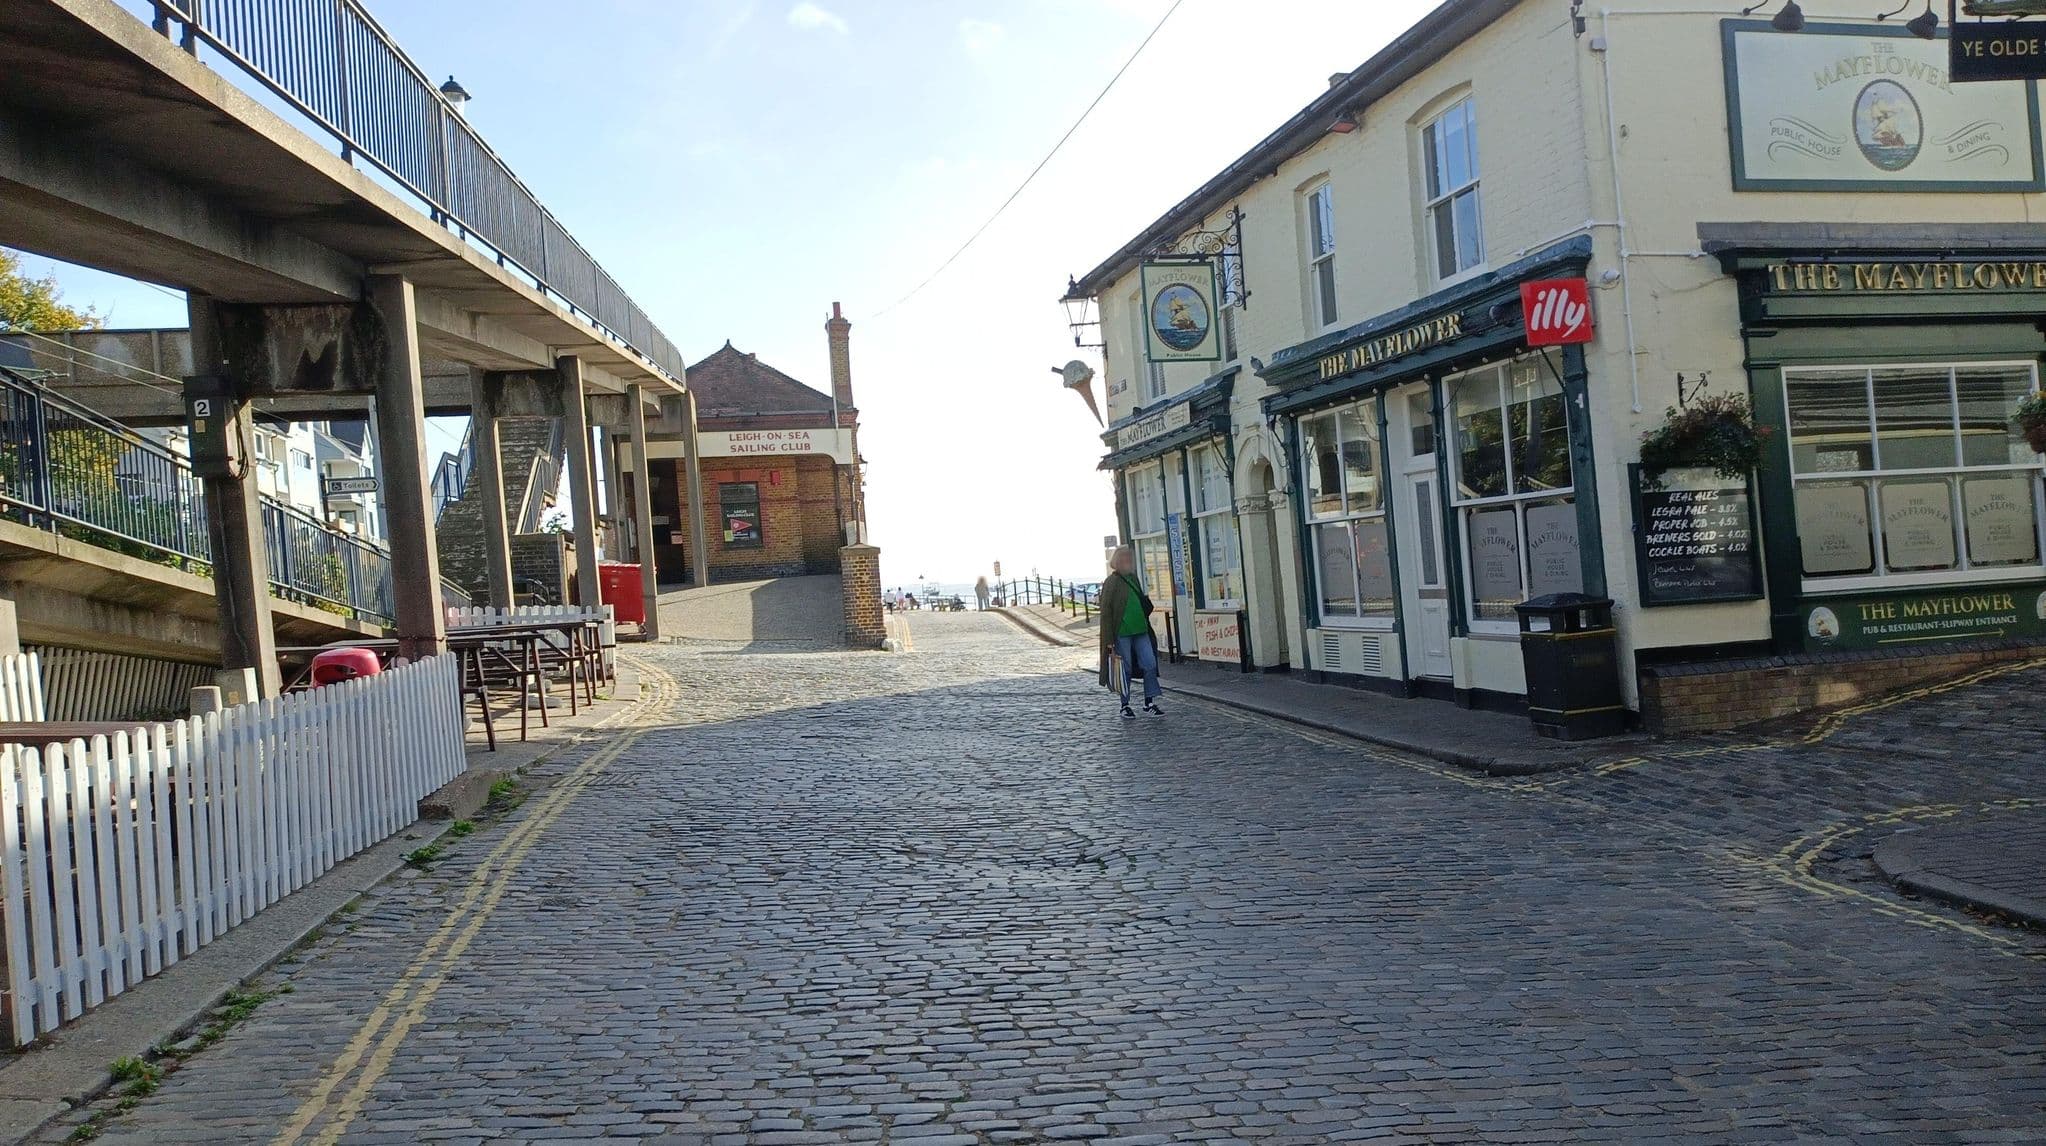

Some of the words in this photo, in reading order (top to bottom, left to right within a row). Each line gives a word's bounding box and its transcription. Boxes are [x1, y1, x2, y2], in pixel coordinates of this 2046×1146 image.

[1962, 41, 1984, 56] YE
[1990, 40, 2039, 56] OLDE
[1814, 54, 1954, 95] MAYFLOWER
[1771, 127, 1805, 144] PUBLIC
[1808, 138, 1841, 156] HOUSE
[1957, 132, 1991, 152] DINING
[1768, 264, 1842, 291] THE
[1530, 288, 1586, 338] illy
[1318, 352, 1347, 380] THE
[1352, 313, 1462, 370] MAYFLOWER
[197, 401, 208, 415] 2
[730, 444, 776, 453] SAILING
[781, 443, 811, 451] CLUB
[1669, 492, 1693, 503] REAL
[1695, 490, 1720, 501] ALES
[1684, 505, 1709, 515] PALE
[1652, 519, 1688, 532] PROPER
[1690, 518, 1708, 528] JOB
[1645, 532, 1691, 545] BREWERS
[1692, 531, 1717, 541] GOLD
[1648, 546, 1684, 557] COCKLE
[1686, 544, 1717, 555] BOATS
[1857, 602, 1897, 621] THE
[1903, 593, 2016, 617] MAYFLOWER
[1863, 625, 1879, 634] PUB
[1880, 625, 1887, 633] &
[1975, 615, 2018, 626] ENTRANCE
